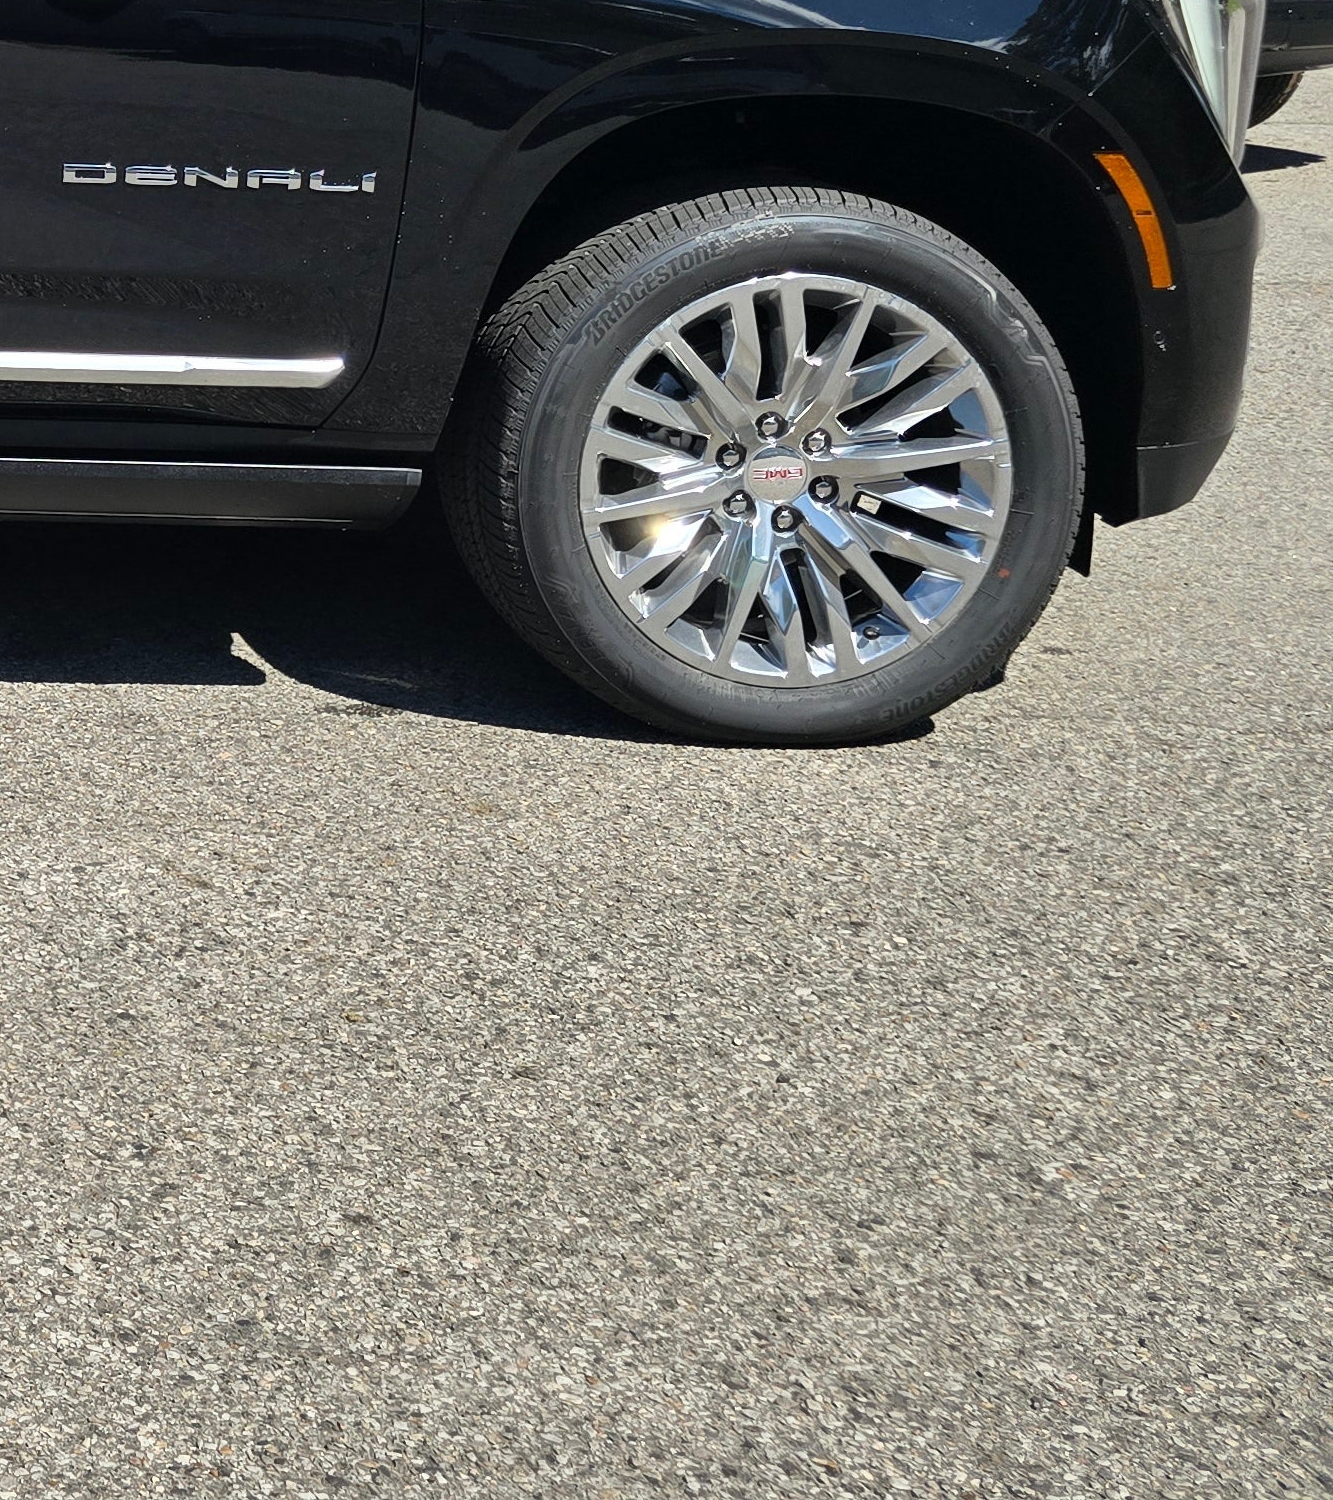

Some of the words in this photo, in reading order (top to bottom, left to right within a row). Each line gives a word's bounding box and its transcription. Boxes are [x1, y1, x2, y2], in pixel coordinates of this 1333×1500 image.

[62, 162, 377, 193] DENALI
[584, 241, 724, 347] BRIDGESTONE
[753, 466, 803, 481] GMC
